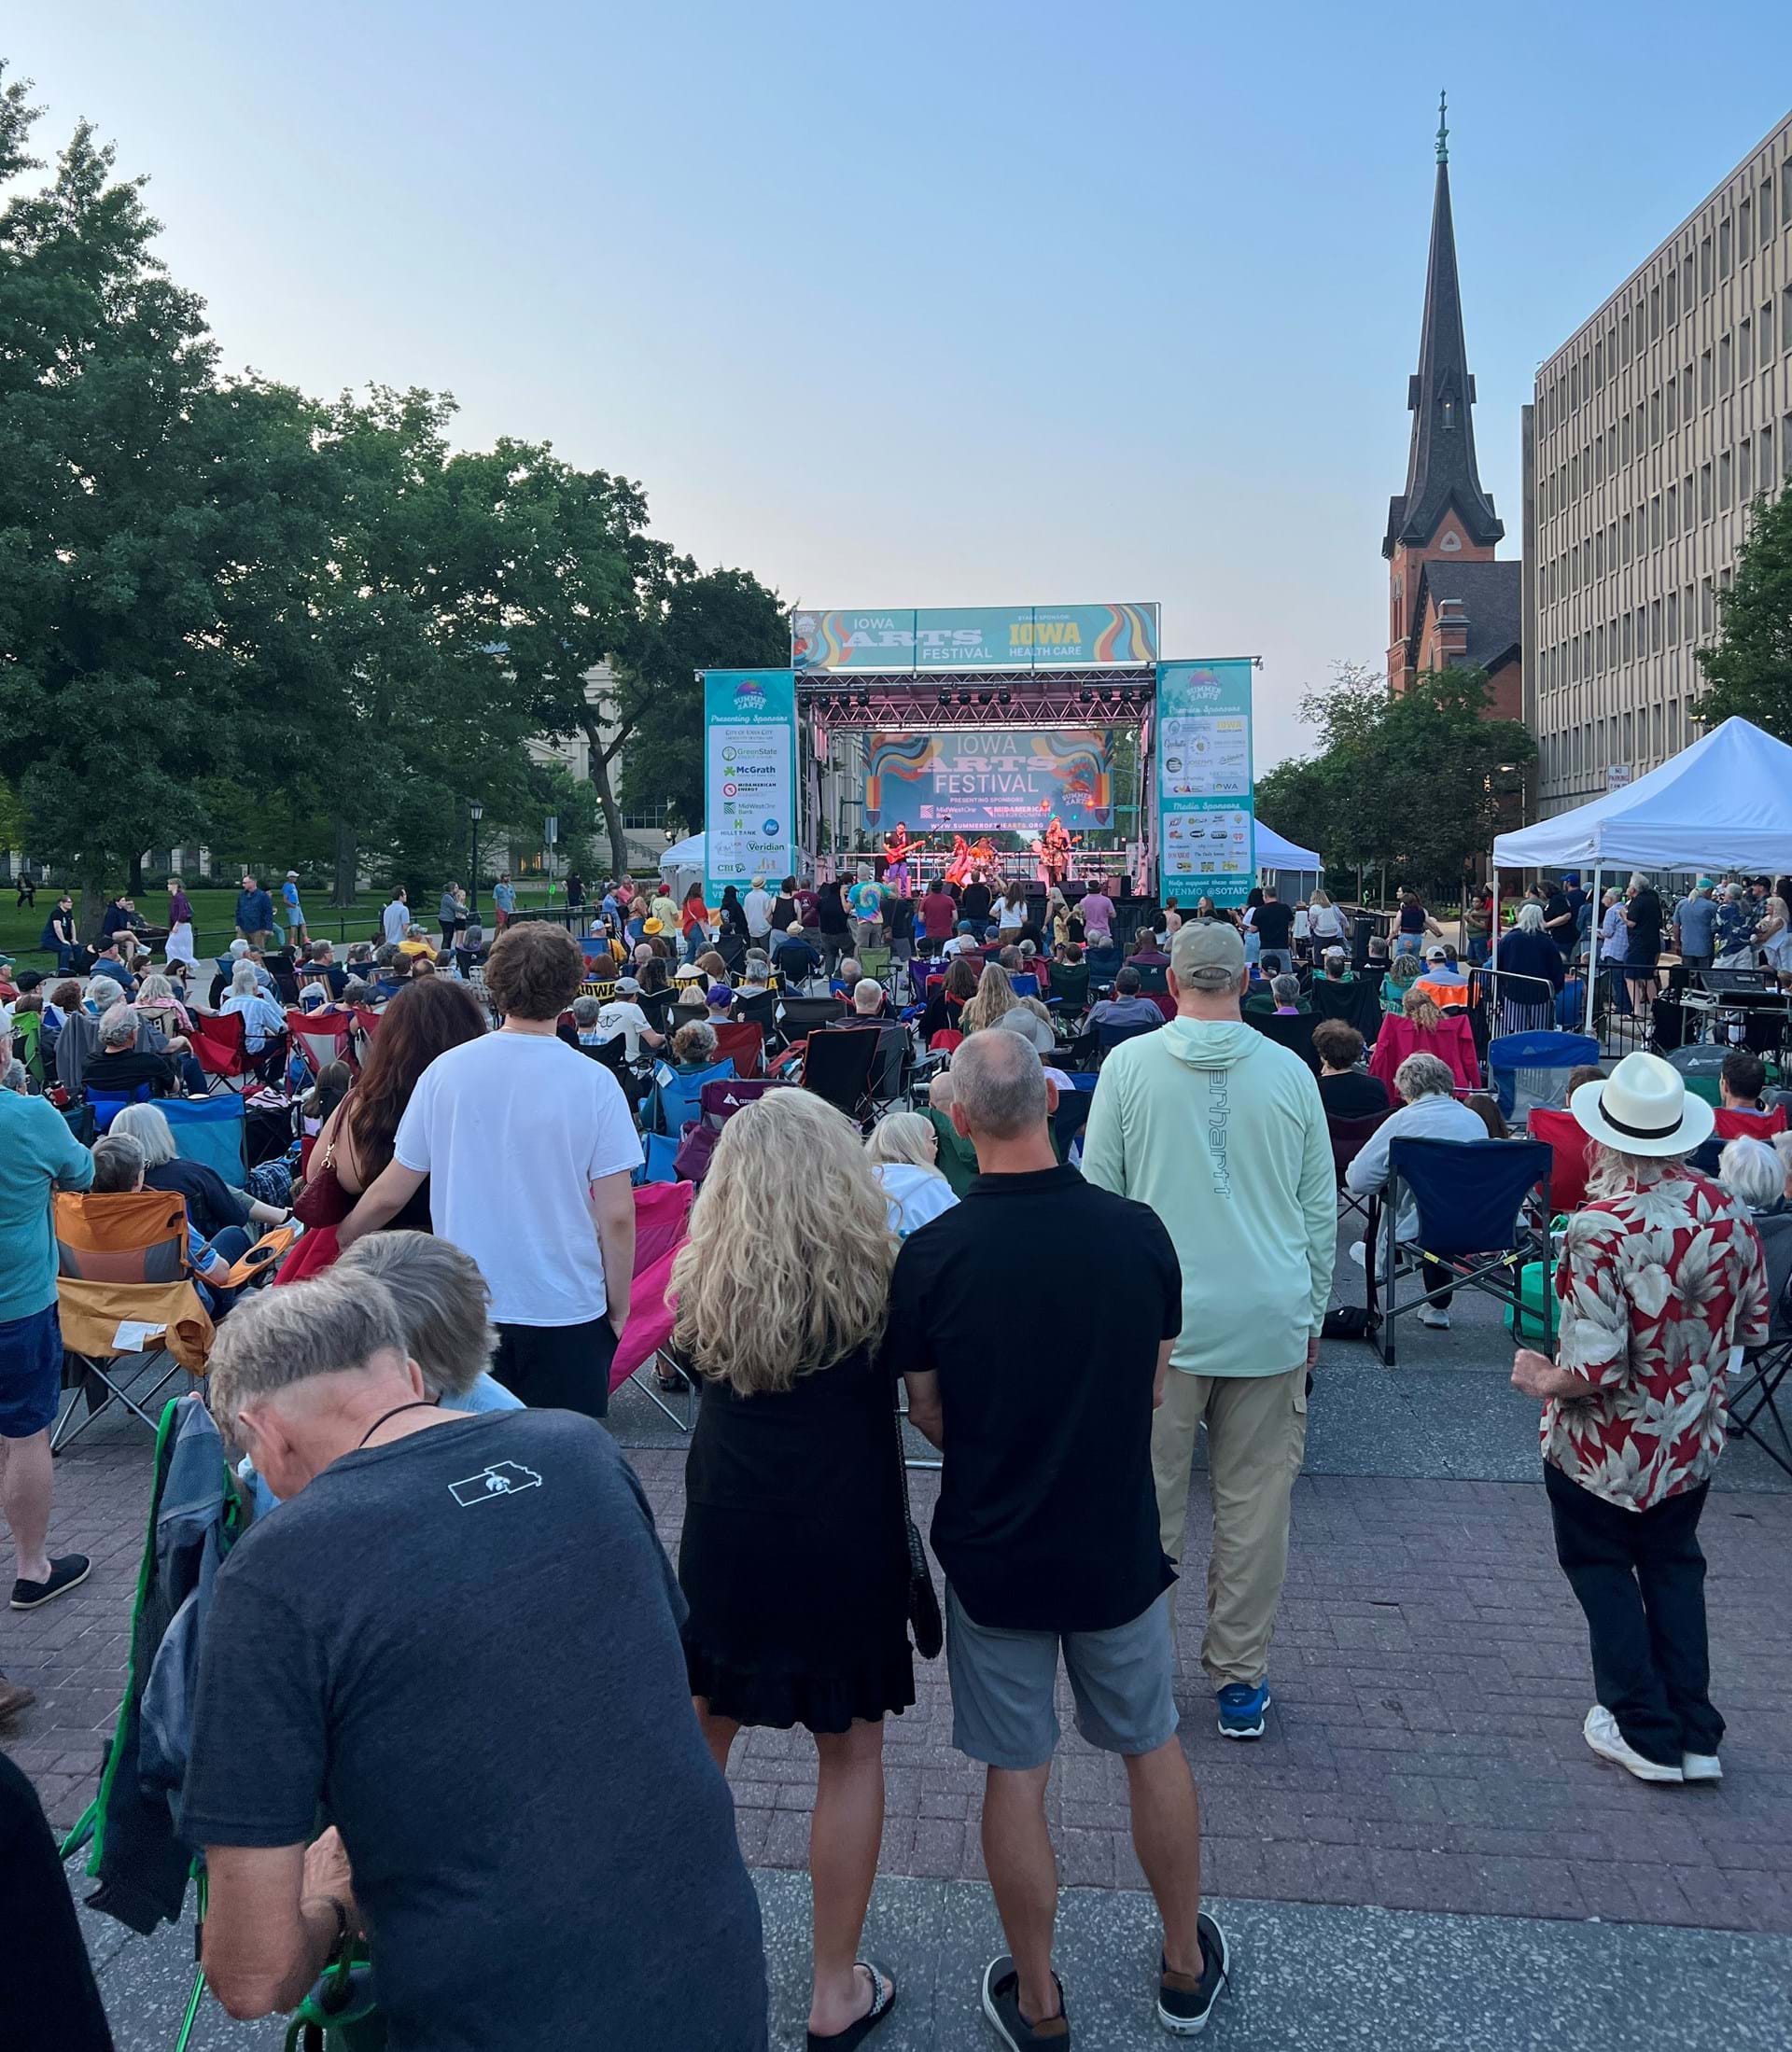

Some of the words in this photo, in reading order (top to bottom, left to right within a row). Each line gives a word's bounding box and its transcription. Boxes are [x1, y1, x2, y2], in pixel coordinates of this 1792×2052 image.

[853, 618, 895, 630] IOWA
[842, 629, 982, 648] ARTS
[1010, 622, 1081, 645] IOWA
[923, 648, 992, 660] FESTIVAL
[1010, 648, 1051, 657] HEALTH
[1053, 646, 1082, 655] CARE
[1187, 686, 1221, 696] SUMMER
[734, 695, 766, 705] SUMMER
[711, 715, 749, 724] Presenting
[753, 714, 788, 723] Sponsors
[957, 735, 1017, 755] IOWA
[917, 756, 1057, 773] ARTS
[935, 774, 1038, 794] FESTIVAL
[1062, 792, 1092, 802] SUMMER
[1173, 802, 1199, 810] Media
[1202, 802, 1239, 811] Sponsors
[749, 842, 785, 851] Veridian
[1207, 886, 1248, 896] @SOTAIC
[1210, 1068, 1231, 1199] arhartt
